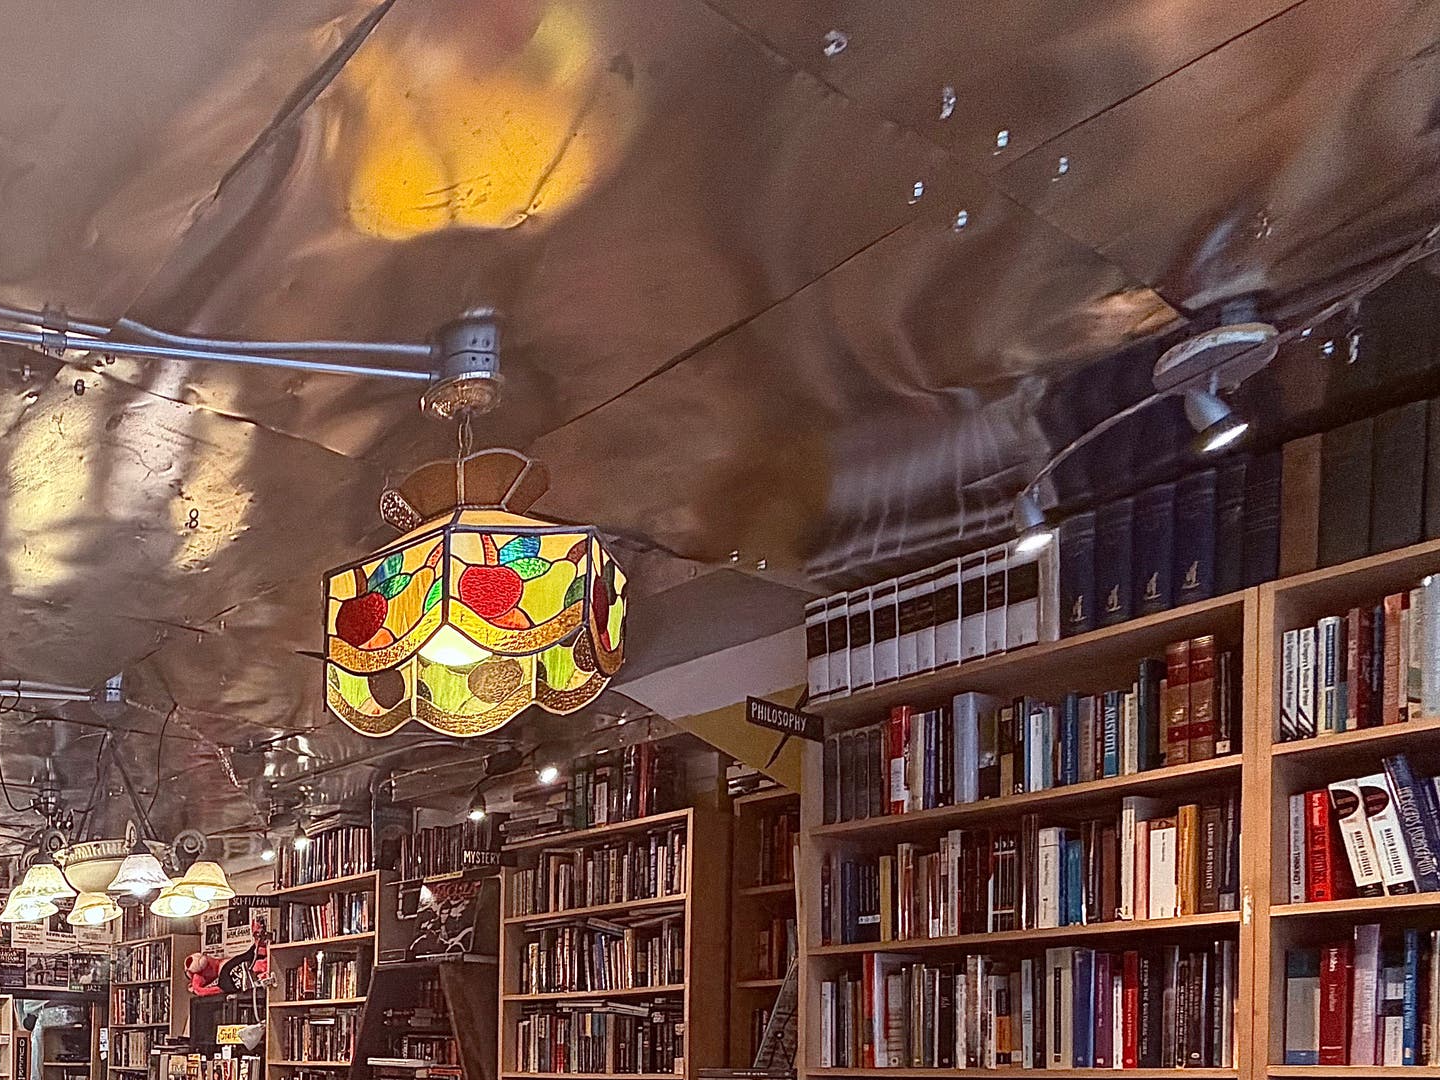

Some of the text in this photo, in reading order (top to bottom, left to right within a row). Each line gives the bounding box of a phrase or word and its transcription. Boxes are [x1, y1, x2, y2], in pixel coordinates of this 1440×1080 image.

[751, 701, 808, 732] PHILOSOPHY
[1104, 705, 1117, 756] ARISTOTLE
[463, 850, 501, 865] MYSTERY
[1205, 847, 1214, 890] AND POLITICS
[18, 1038, 26, 1077] QUEER
